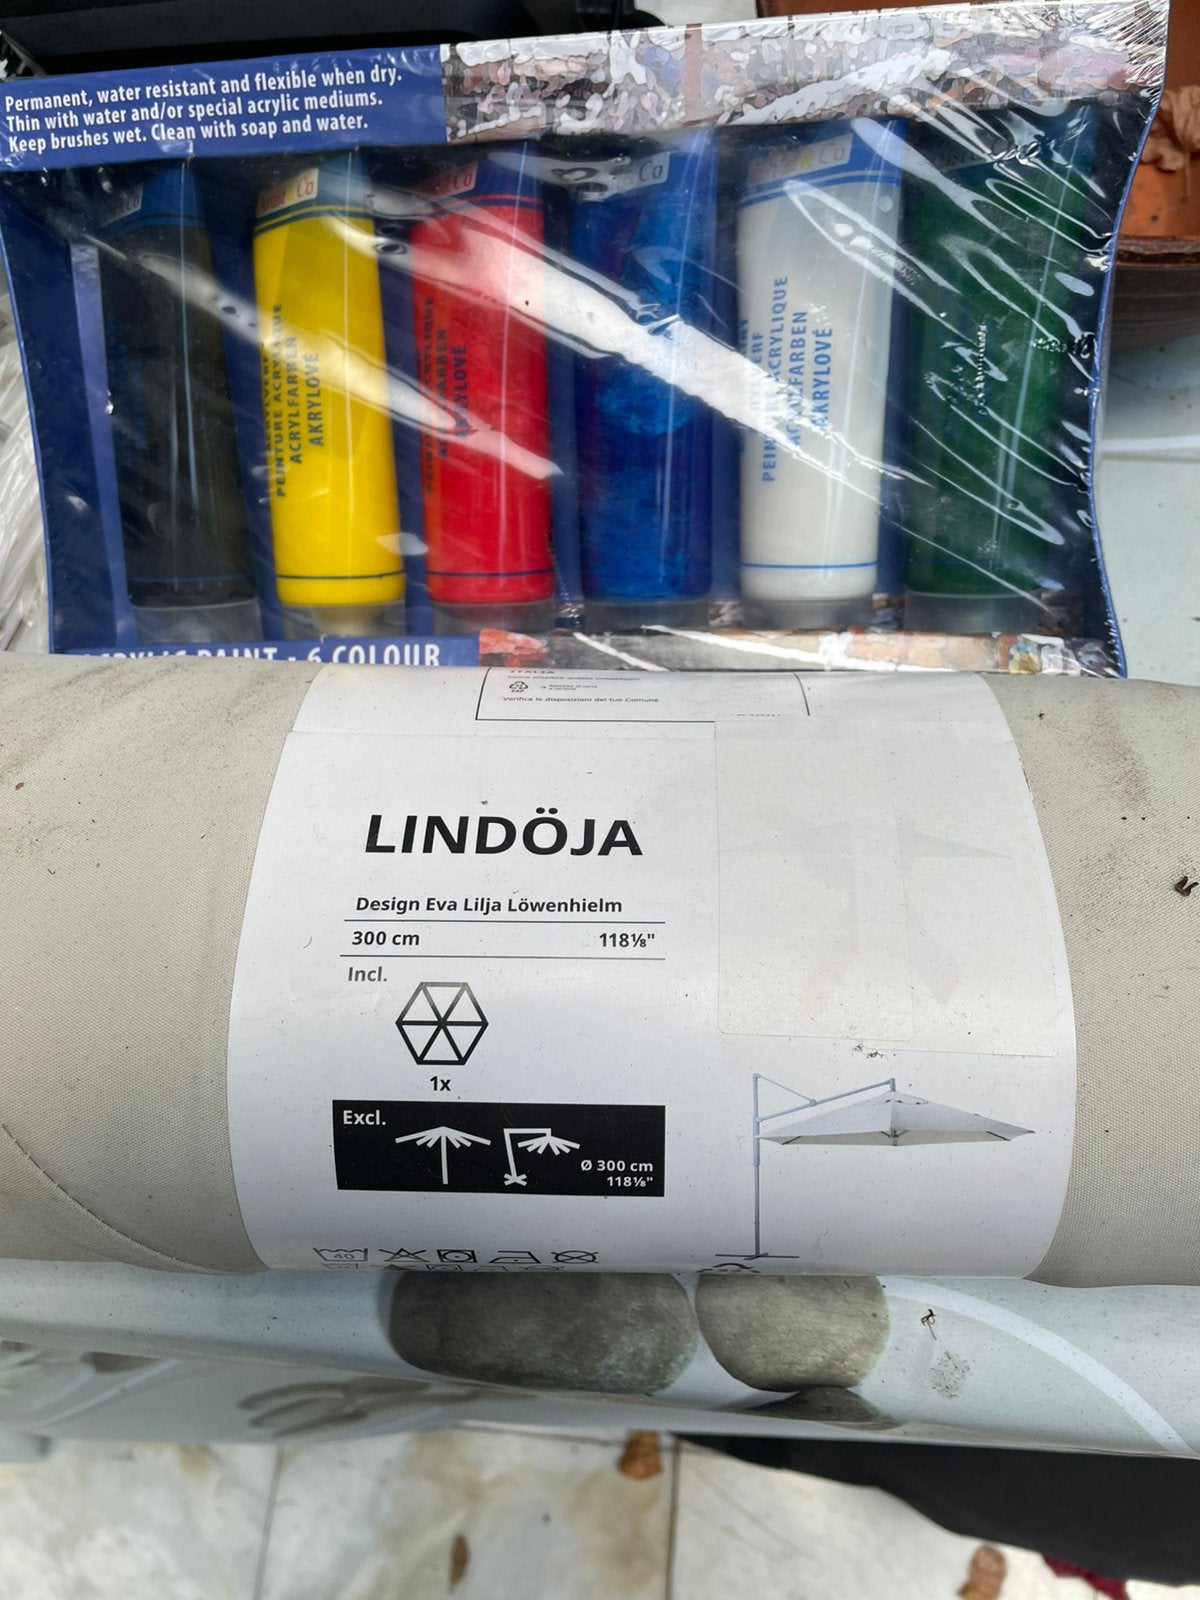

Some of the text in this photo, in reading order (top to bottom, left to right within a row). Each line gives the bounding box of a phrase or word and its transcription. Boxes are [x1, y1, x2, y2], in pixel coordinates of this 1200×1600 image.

[5, 64, 402, 113] Permanent, water resistant and flexible when dry.
[7, 89, 383, 133] Thin with water and/or special acrylic mediums.
[9, 113, 368, 155] Keep brushes wet. Clean with soap and water.
[423, 297, 434, 396] CRYLIQUE
[285, 336, 302, 464] ACRYLFARBEN
[302, 353, 324, 447] AKRYLOVÉ
[436, 328, 449, 458] ACFARBEN
[761, 276, 788, 482] PEINURE ACRYLIQUE
[811, 328, 833, 428] AKRYLOVÉ
[272, 410, 286, 497] PEINTURE
[332, 644, 440, 667] COLOUR
[365, 807, 644, 856] LINDÖJA
[355, 897, 622, 916] Design Eva Lilja Löwenhielm
[352, 931, 387, 946] 300
[392, 934, 420, 946] cm
[348, 966, 388, 983] Incl.
[430, 1076, 451, 1092] 1x
[342, 1109, 387, 1126] Excl.
[597, 1160, 626, 1172] 300
[630, 1162, 653, 1172] cm
